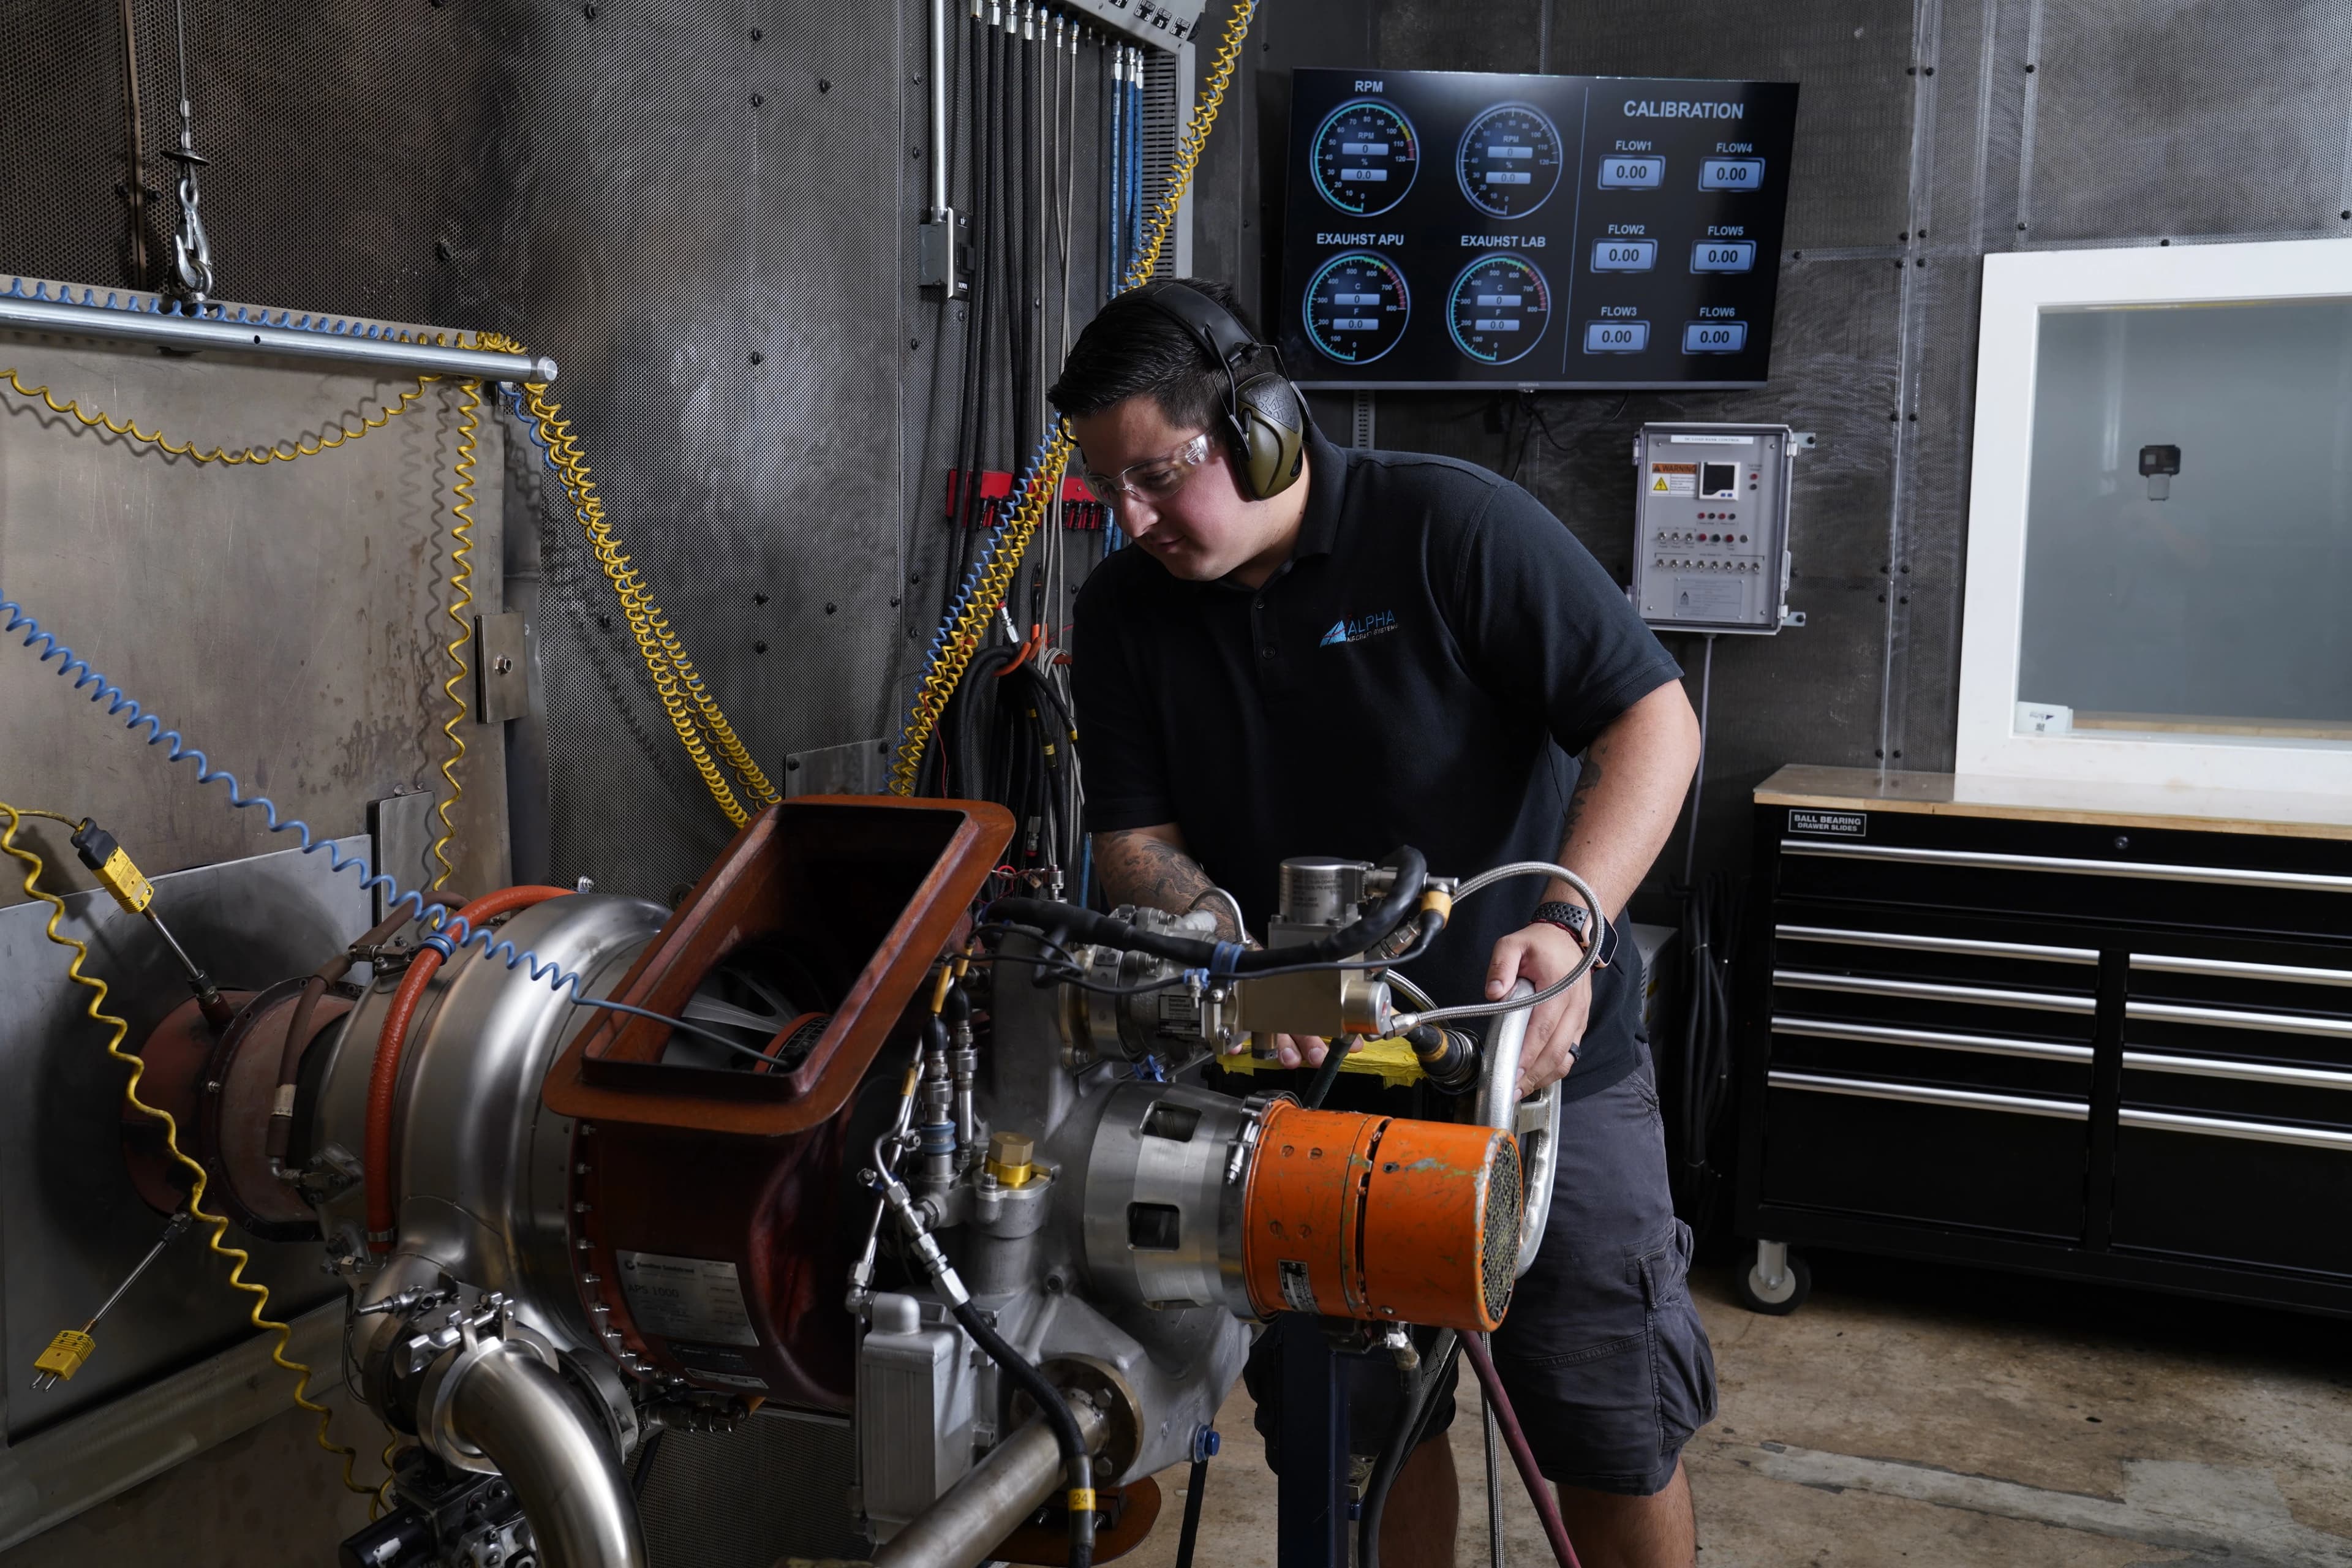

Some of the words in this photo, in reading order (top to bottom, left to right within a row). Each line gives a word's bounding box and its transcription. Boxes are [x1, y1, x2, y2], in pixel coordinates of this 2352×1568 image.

[1355, 81, 1383, 92] RPM
[1623, 100, 1744, 119] CALIBRATION
[1616, 140, 1652, 151] FLOW1
[1716, 143, 1752, 154] FLOW4
[1357, 171, 1371, 179] 0.0
[1616, 165, 1647, 179] 0.00
[1717, 167, 1747, 181] 0.00
[1608, 224, 1645, 235] FLOW2
[1708, 226, 1744, 236] FLOW5
[1317, 233, 1376, 246] EXAUHST
[1378, 235, 1404, 246] APU
[1461, 236, 1518, 247] EXAUHST
[1521, 236, 1545, 247] LAB
[1609, 249, 1639, 262] 0.00
[1708, 249, 1738, 263] 0.00
[1600, 306, 1637, 317] FLOW3
[1700, 307, 1735, 318] FLOW6
[1602, 330, 1632, 344] 0.00
[1700, 330, 1730, 344] 0.00
[1348, 609, 1395, 636] ALPHA
[1820, 816, 1861, 825] BEARING
[628, 1284, 648, 1295] APS
[1073, 1493, 1087, 1504] 24
